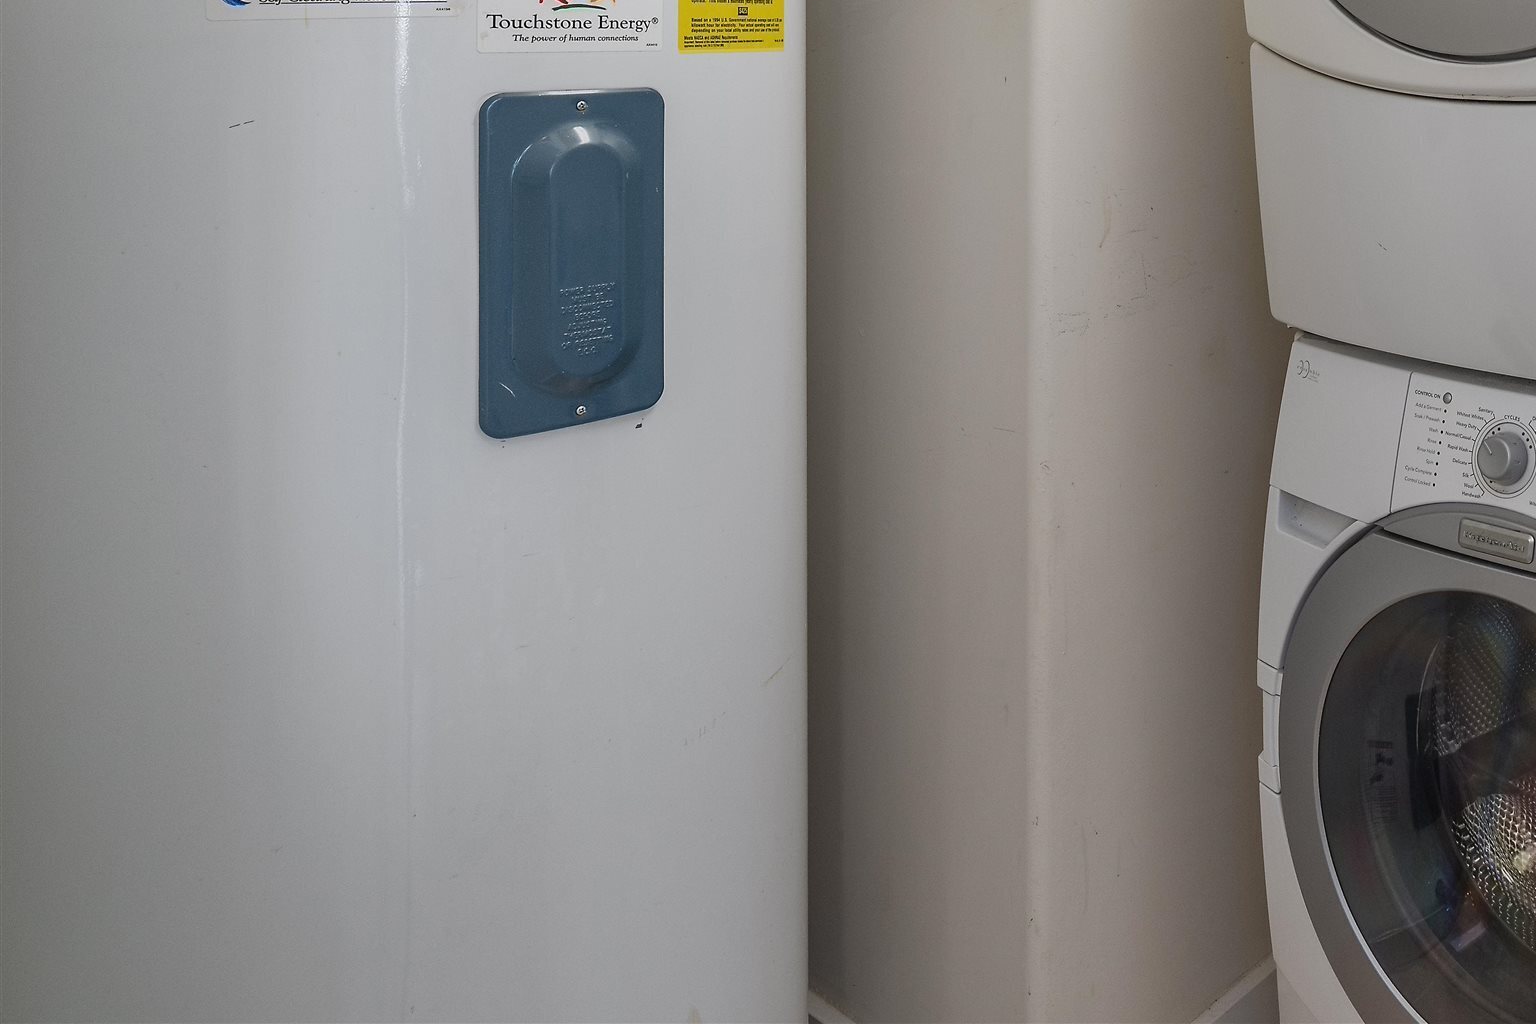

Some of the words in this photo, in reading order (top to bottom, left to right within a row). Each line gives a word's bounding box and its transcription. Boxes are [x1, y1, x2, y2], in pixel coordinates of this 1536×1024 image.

[486, 14, 592, 29] Touchstone
[531, 35, 557, 43] power
[558, 33, 568, 43] of
[1415, 389, 1434, 398] CONTROL
